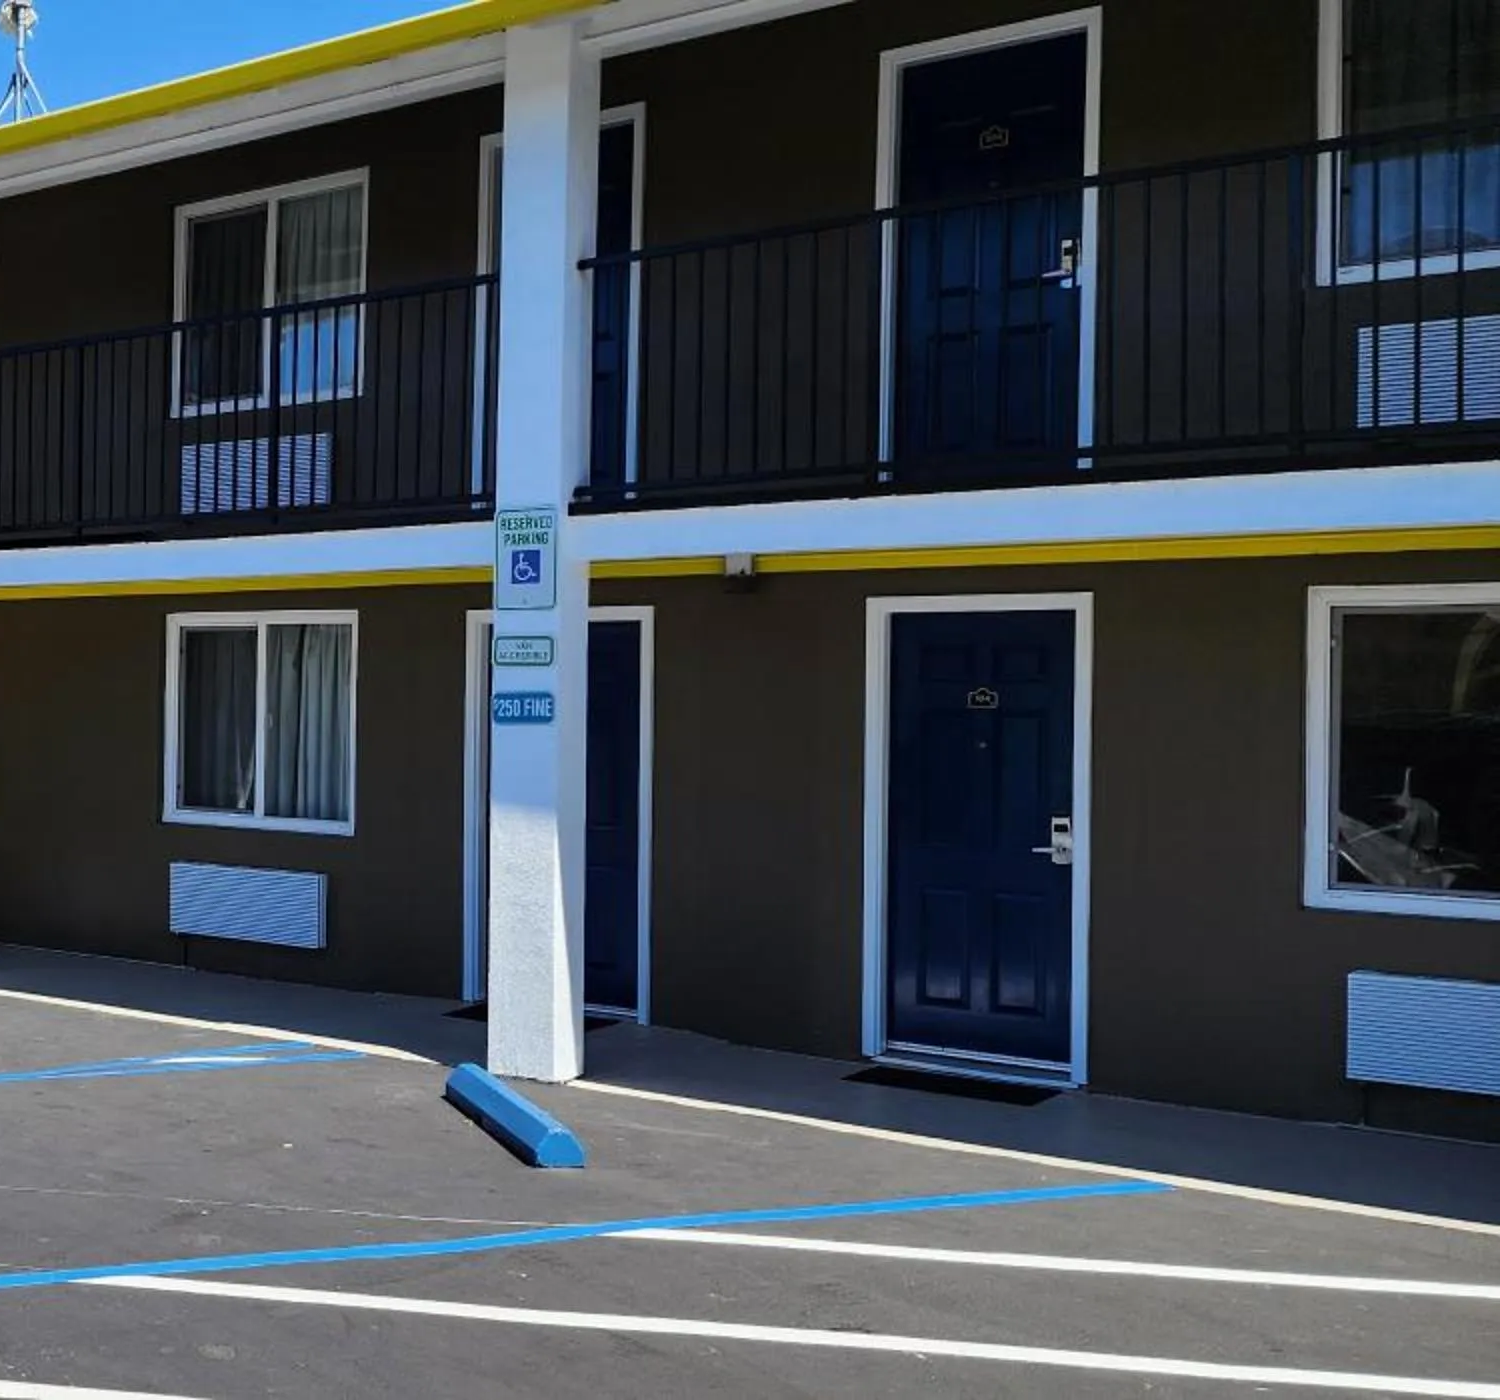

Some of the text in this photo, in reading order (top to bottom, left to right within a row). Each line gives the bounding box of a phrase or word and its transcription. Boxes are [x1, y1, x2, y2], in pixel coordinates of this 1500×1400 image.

[500, 515, 553, 530] RESERVED
[504, 532, 548, 546] PARKING
[523, 697, 552, 717] FINE
